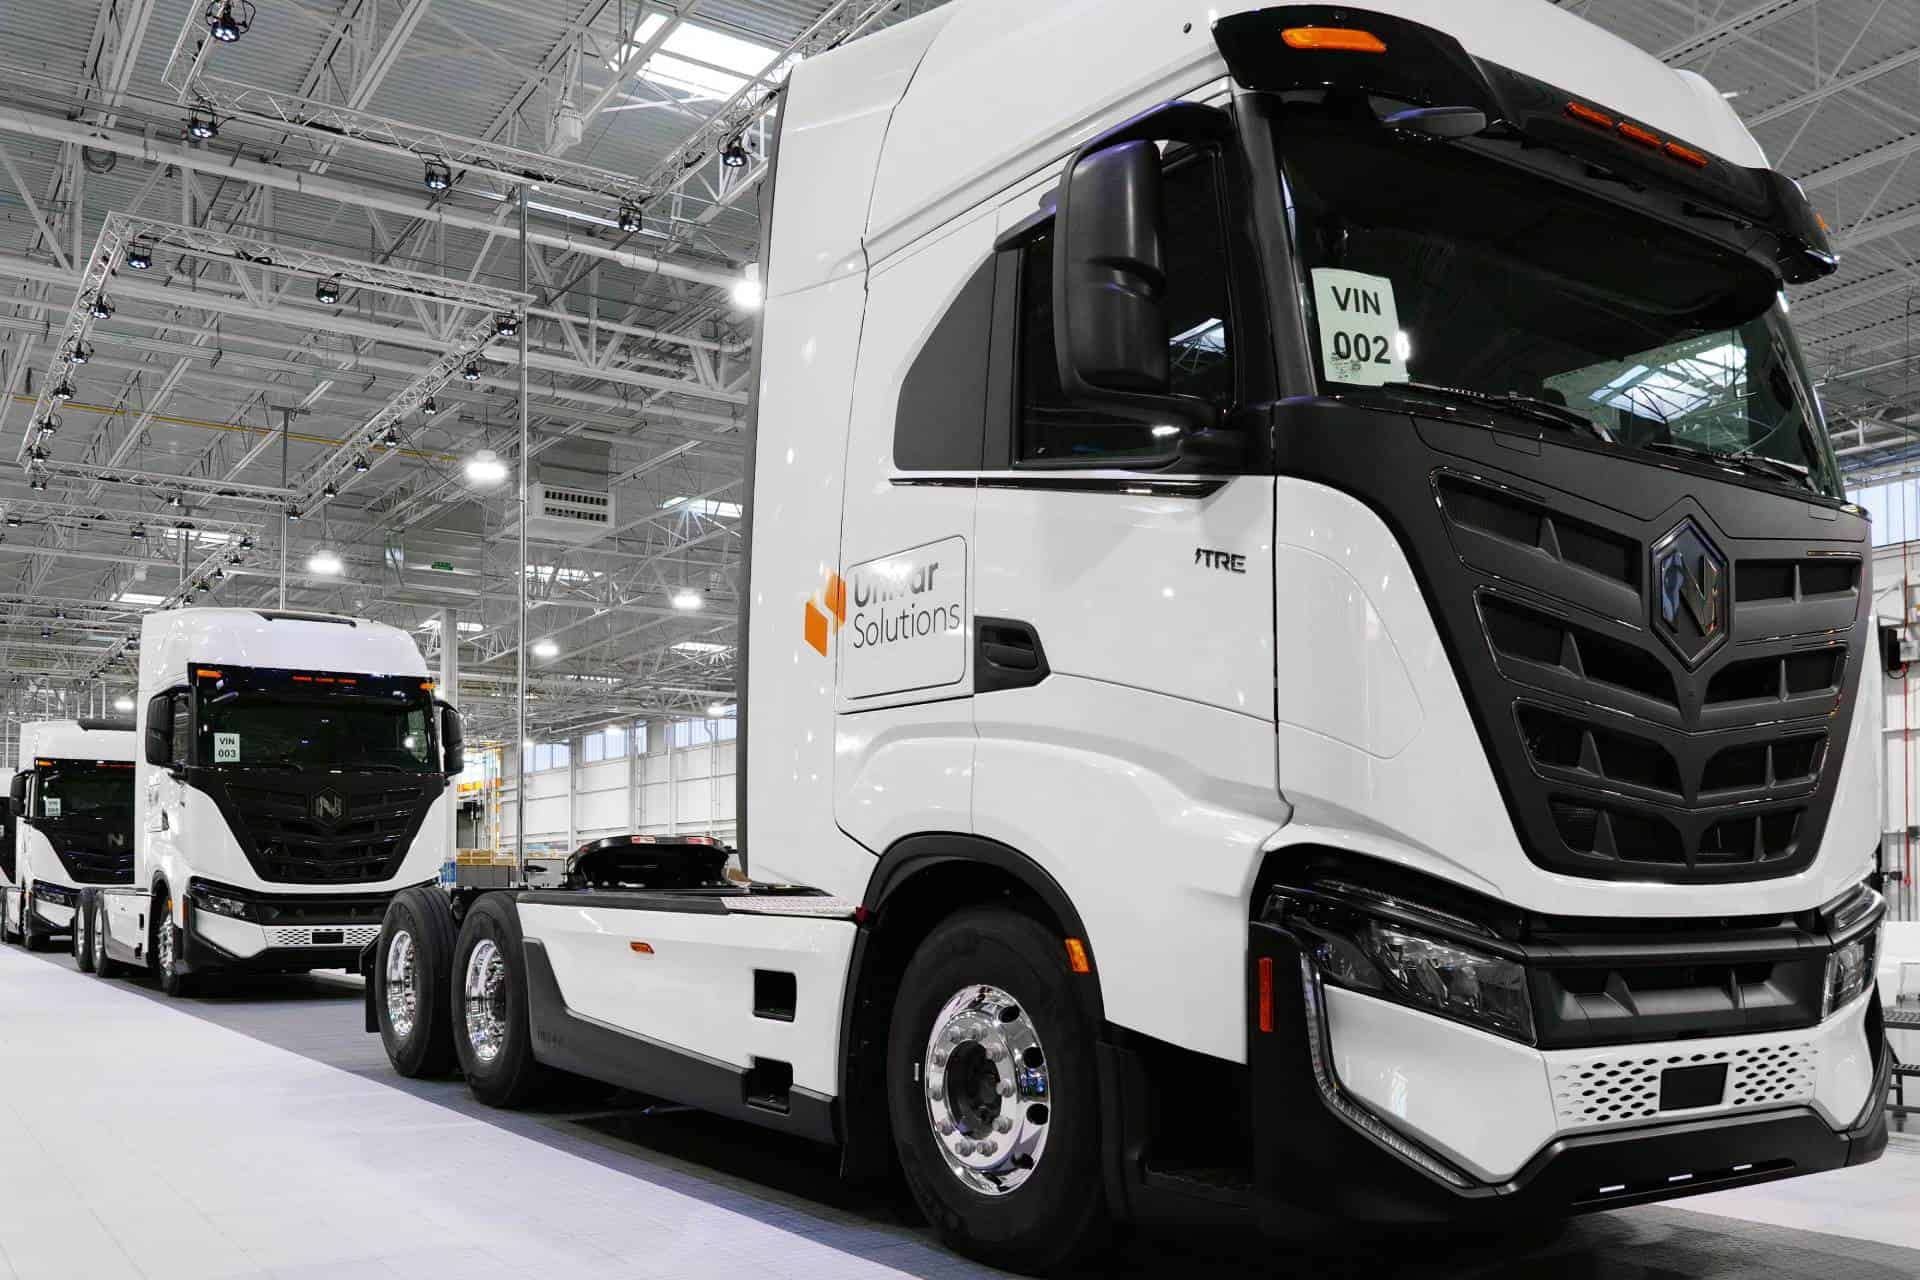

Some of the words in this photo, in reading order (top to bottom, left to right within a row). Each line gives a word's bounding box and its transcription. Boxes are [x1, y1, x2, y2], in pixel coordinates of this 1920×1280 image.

[1330, 285, 1381, 316] VIN
[1333, 331, 1391, 364] 002
[1195, 547, 1246, 574] TRE
[854, 562, 939, 608] Uar
[852, 602, 961, 649] Solutions
[217, 749, 236, 759] 003
[219, 736, 235, 745] VIN
